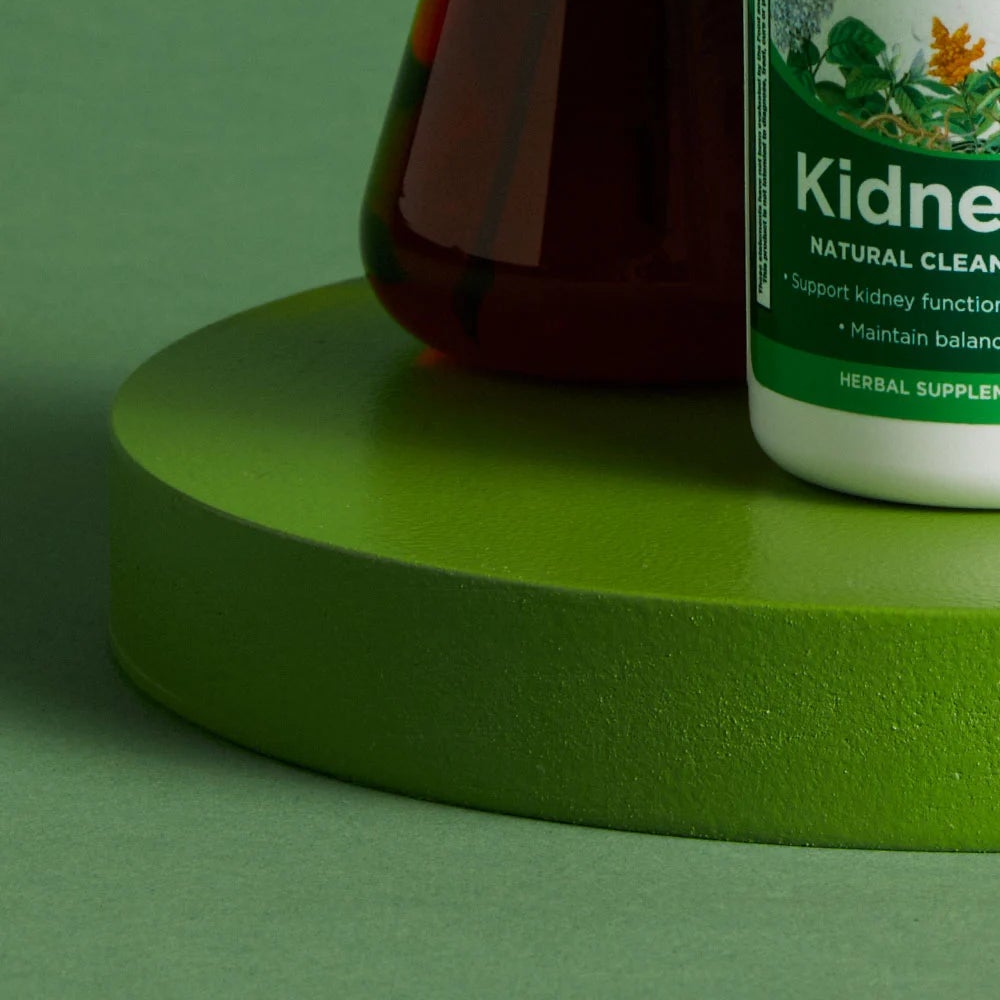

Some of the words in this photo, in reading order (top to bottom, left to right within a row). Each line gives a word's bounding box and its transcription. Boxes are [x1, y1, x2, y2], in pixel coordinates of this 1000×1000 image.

[810, 236, 914, 269] NATURAL
[791, 273, 850, 301] Support
[855, 287, 916, 312] kidney
[851, 322, 929, 347] Maintain
[840, 372, 911, 396] HERBAL
